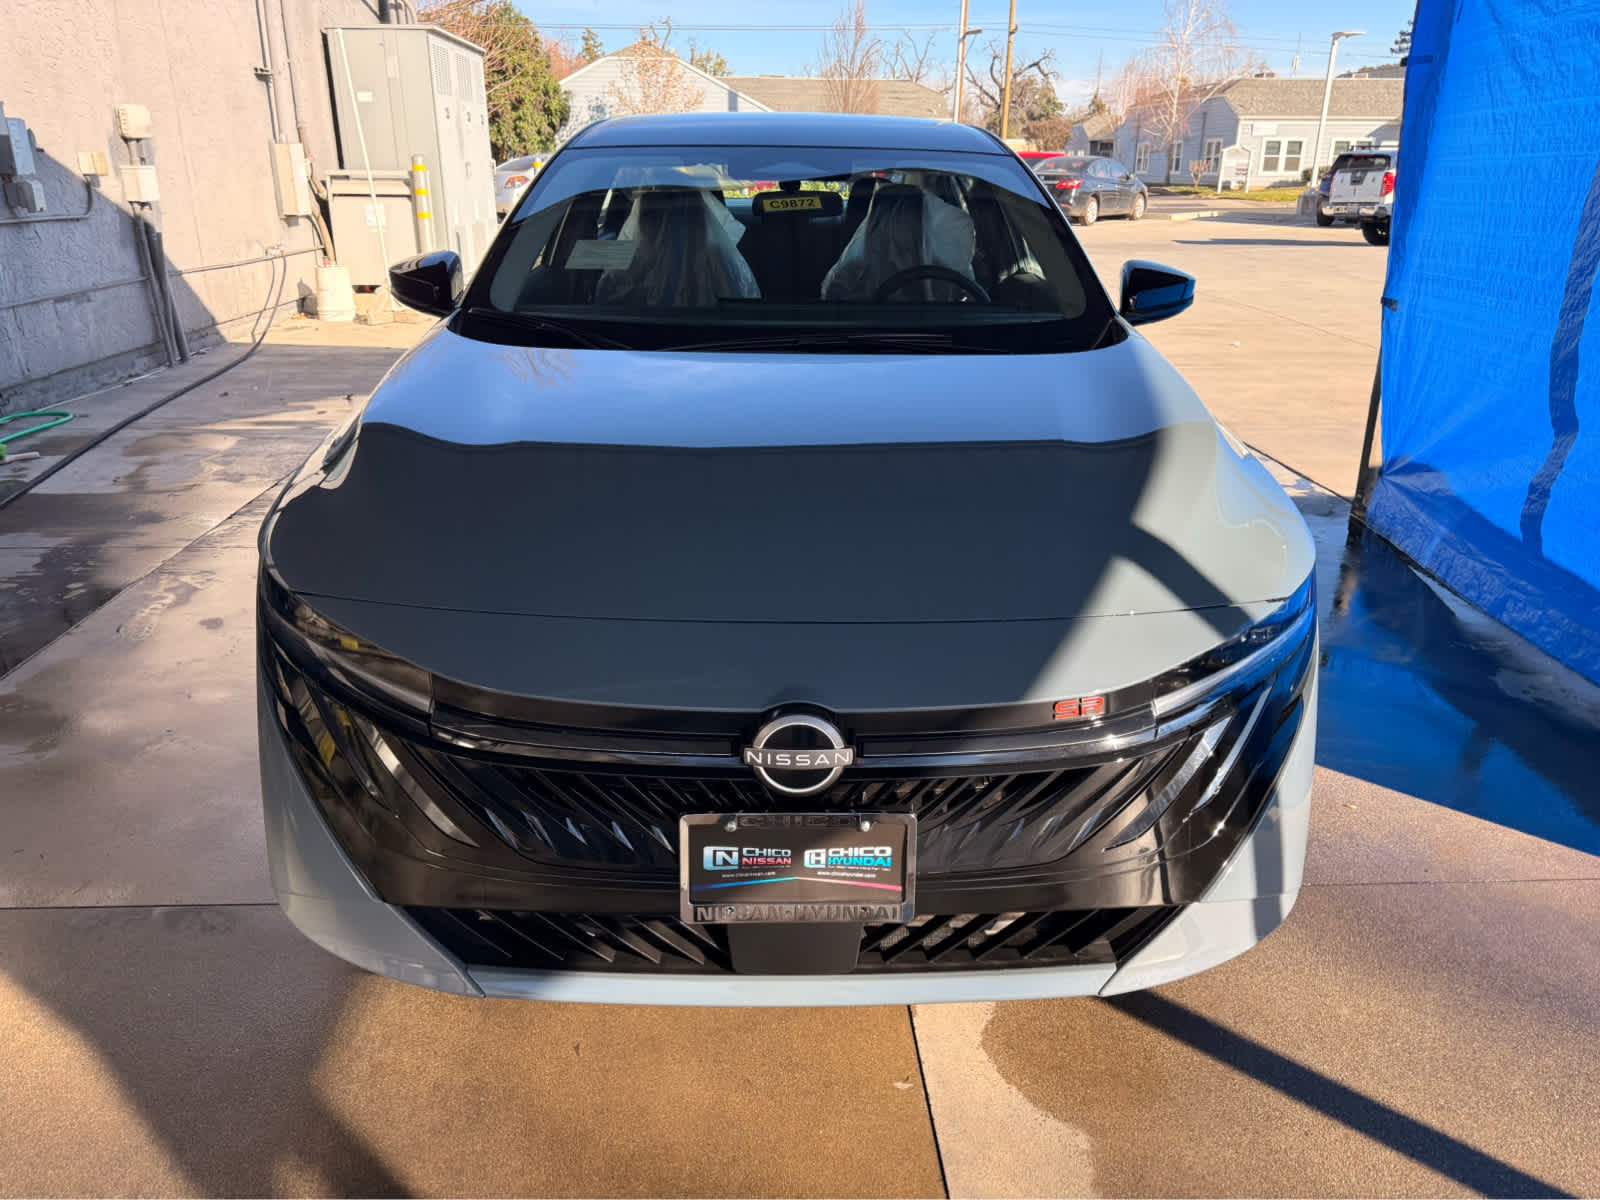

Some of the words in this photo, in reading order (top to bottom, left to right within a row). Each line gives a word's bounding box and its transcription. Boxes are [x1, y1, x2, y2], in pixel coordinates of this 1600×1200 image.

[769, 199, 816, 209] C9872
[1053, 696, 1104, 720] SR
[747, 751, 850, 767] NISSAN
[742, 847, 792, 857] CHICO
[828, 846, 892, 857] CHICO
[742, 857, 792, 865] NISSAN
[828, 856, 892, 868] HYUNDAI
